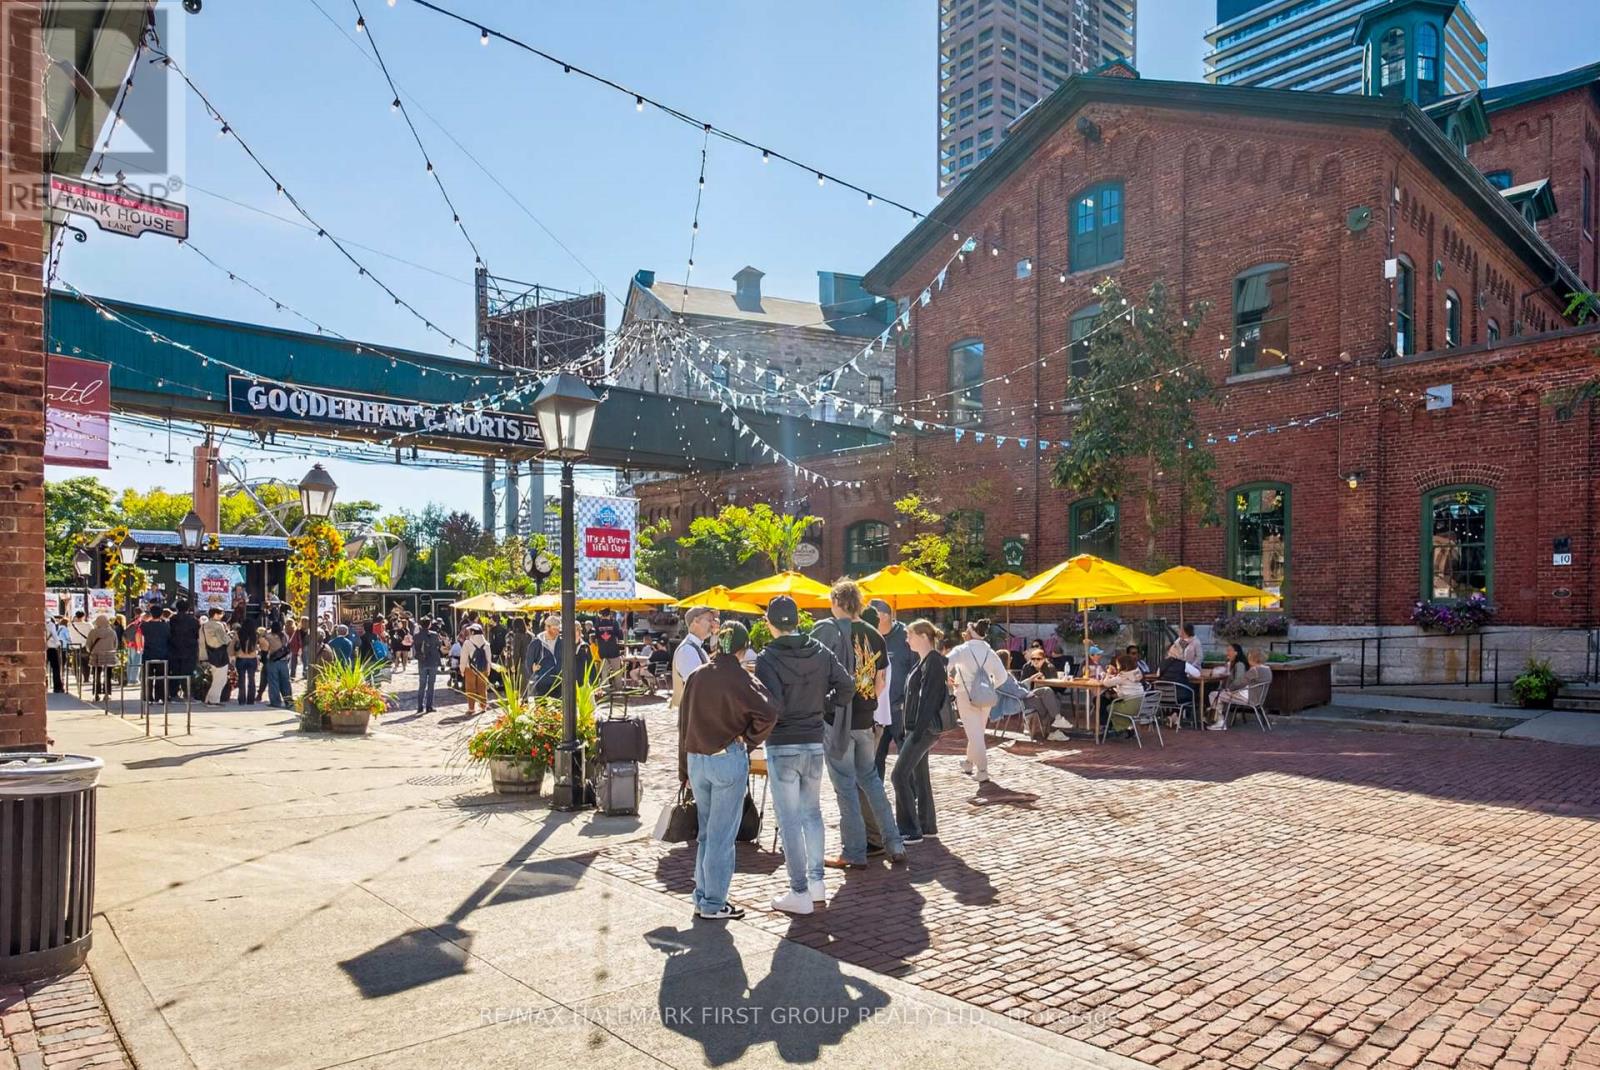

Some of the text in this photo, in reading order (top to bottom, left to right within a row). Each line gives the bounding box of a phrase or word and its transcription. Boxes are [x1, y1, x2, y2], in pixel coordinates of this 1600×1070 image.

[63, 194, 175, 232] TANK HOUSE
[107, 220, 133, 232] LANE
[247, 386, 417, 428] GOODERHAM
[444, 410, 520, 440] WORTS
[1560, 554, 1570, 563] 10
